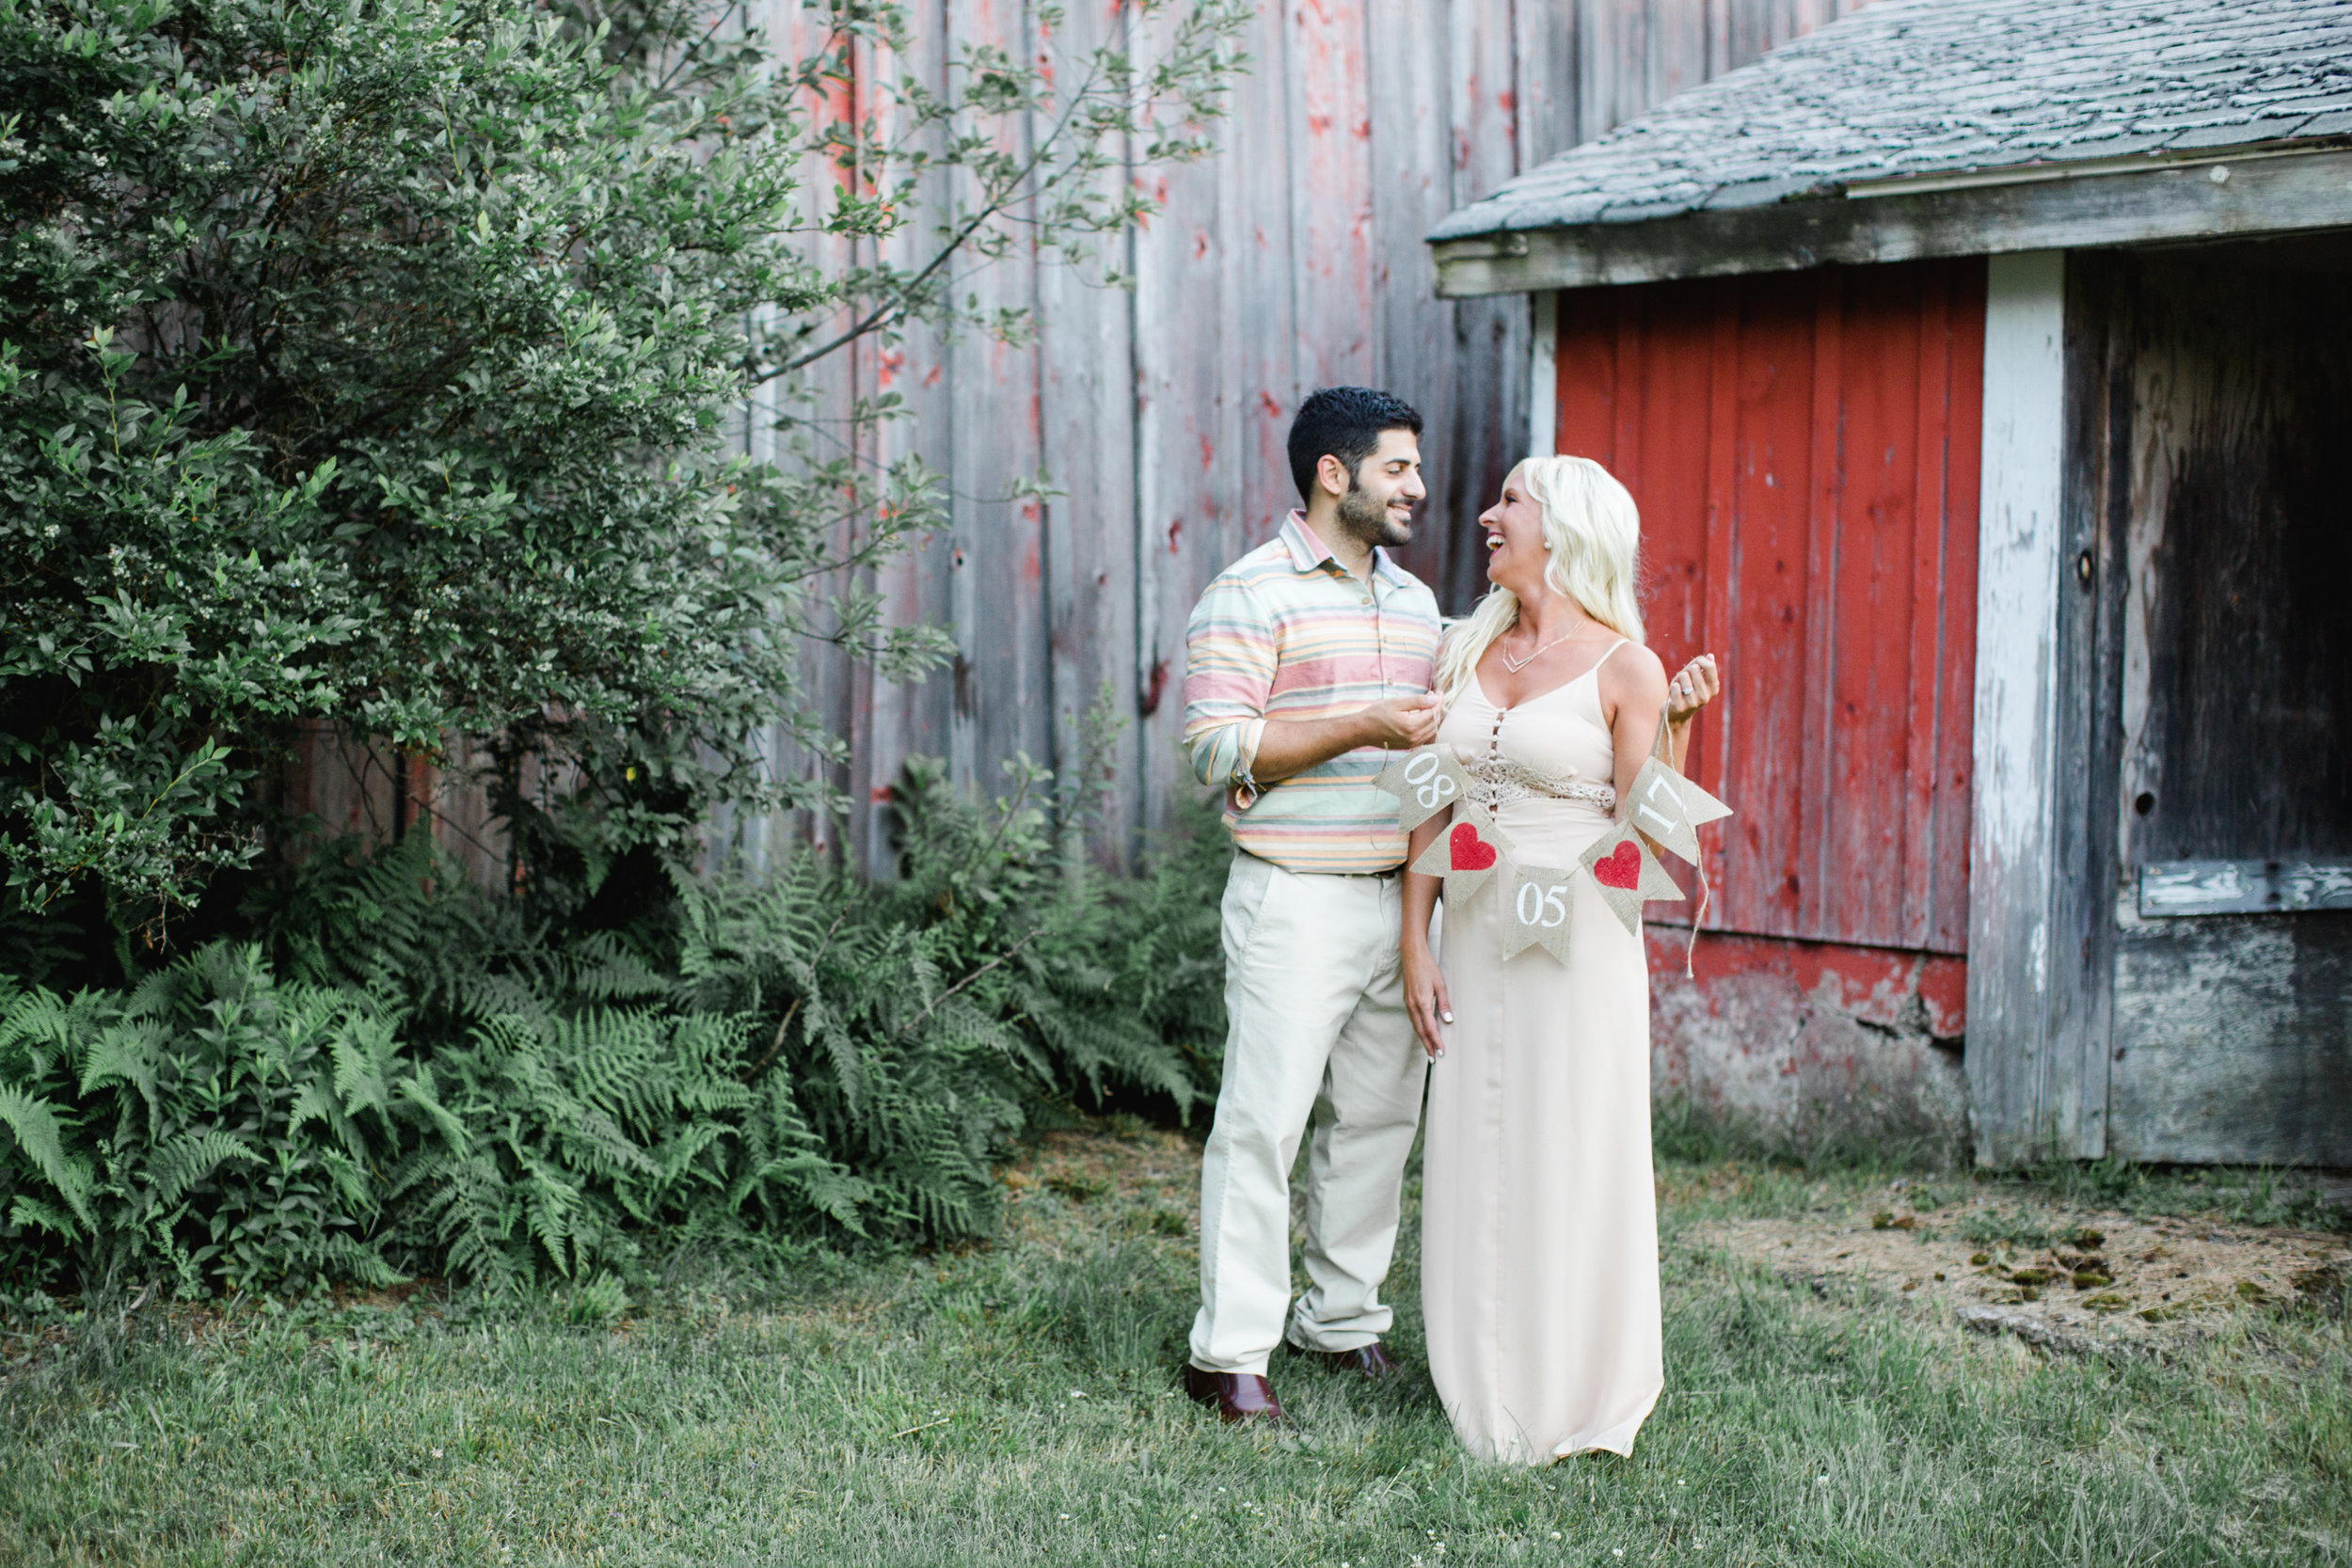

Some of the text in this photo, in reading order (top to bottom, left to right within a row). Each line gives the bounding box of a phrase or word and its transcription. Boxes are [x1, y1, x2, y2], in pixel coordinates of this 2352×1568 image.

[1404, 752, 1455, 809] 08
[1638, 774, 1687, 834] 17
[1517, 881, 1567, 927] 05
